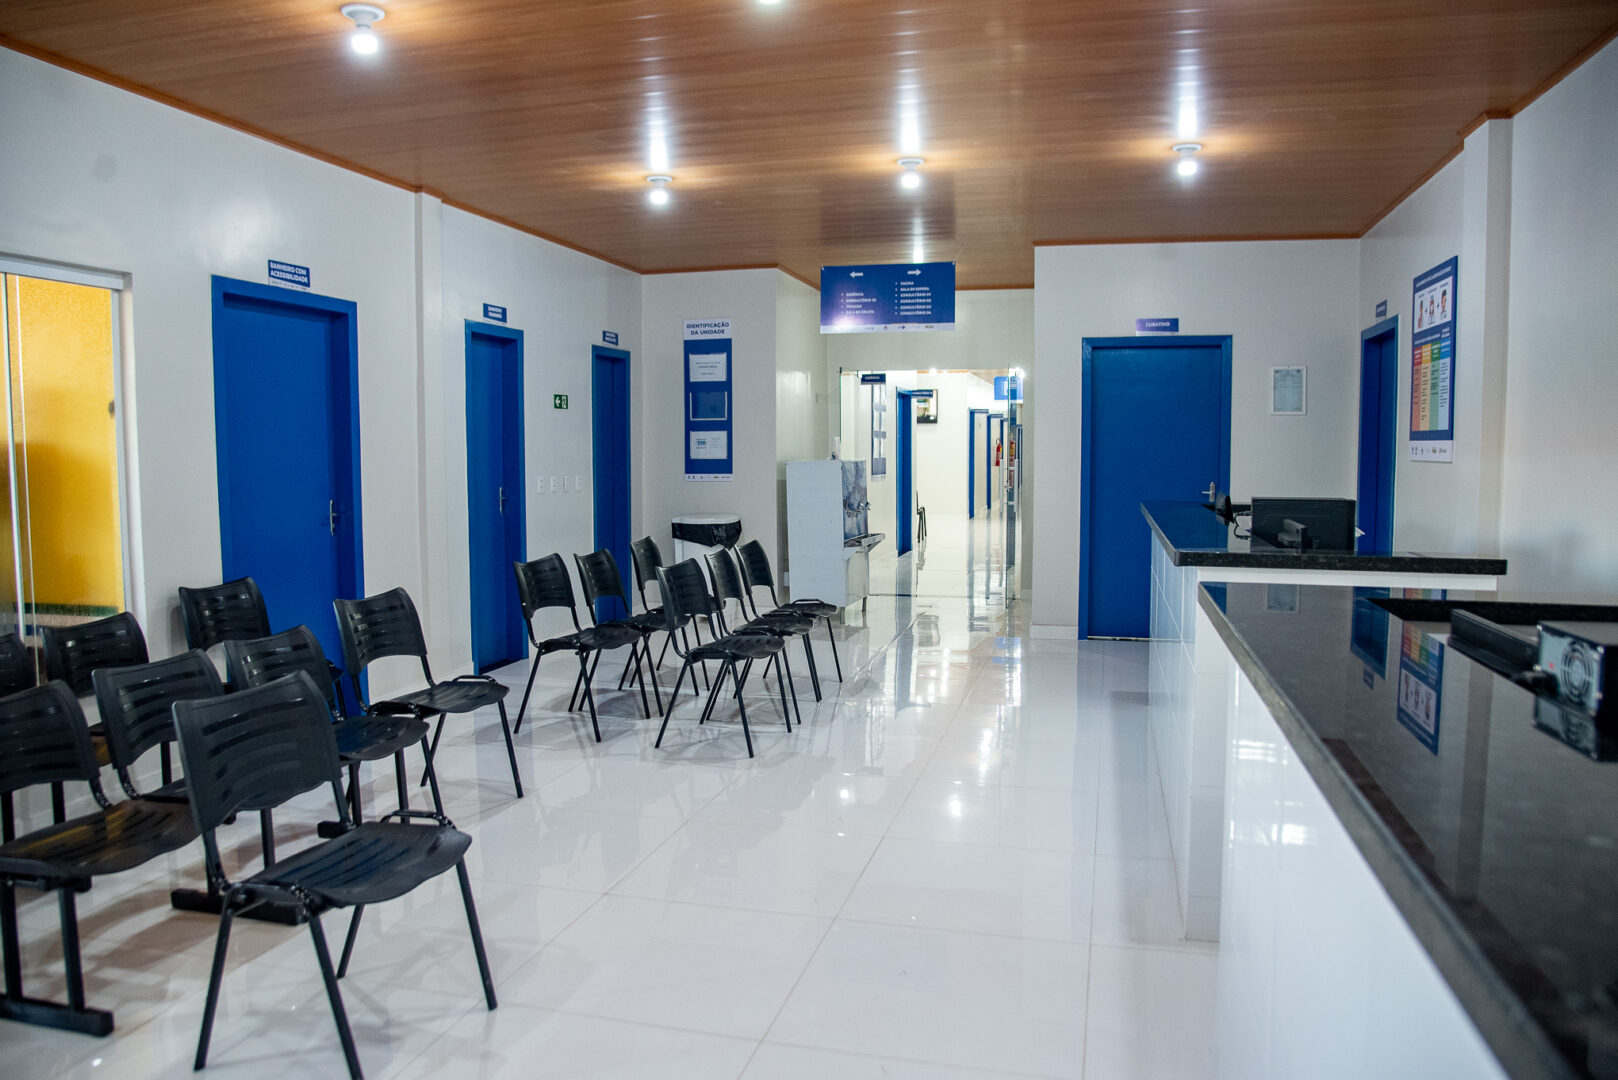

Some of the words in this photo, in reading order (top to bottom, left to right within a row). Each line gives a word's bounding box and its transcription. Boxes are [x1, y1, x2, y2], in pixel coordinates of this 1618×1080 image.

[270, 262, 295, 273] BANHEIRO
[295, 267, 307, 275] COM
[270, 270, 308, 283] ACESSIBILIDADE
[686, 321, 730, 329] IDENTIFICAÇÃO
